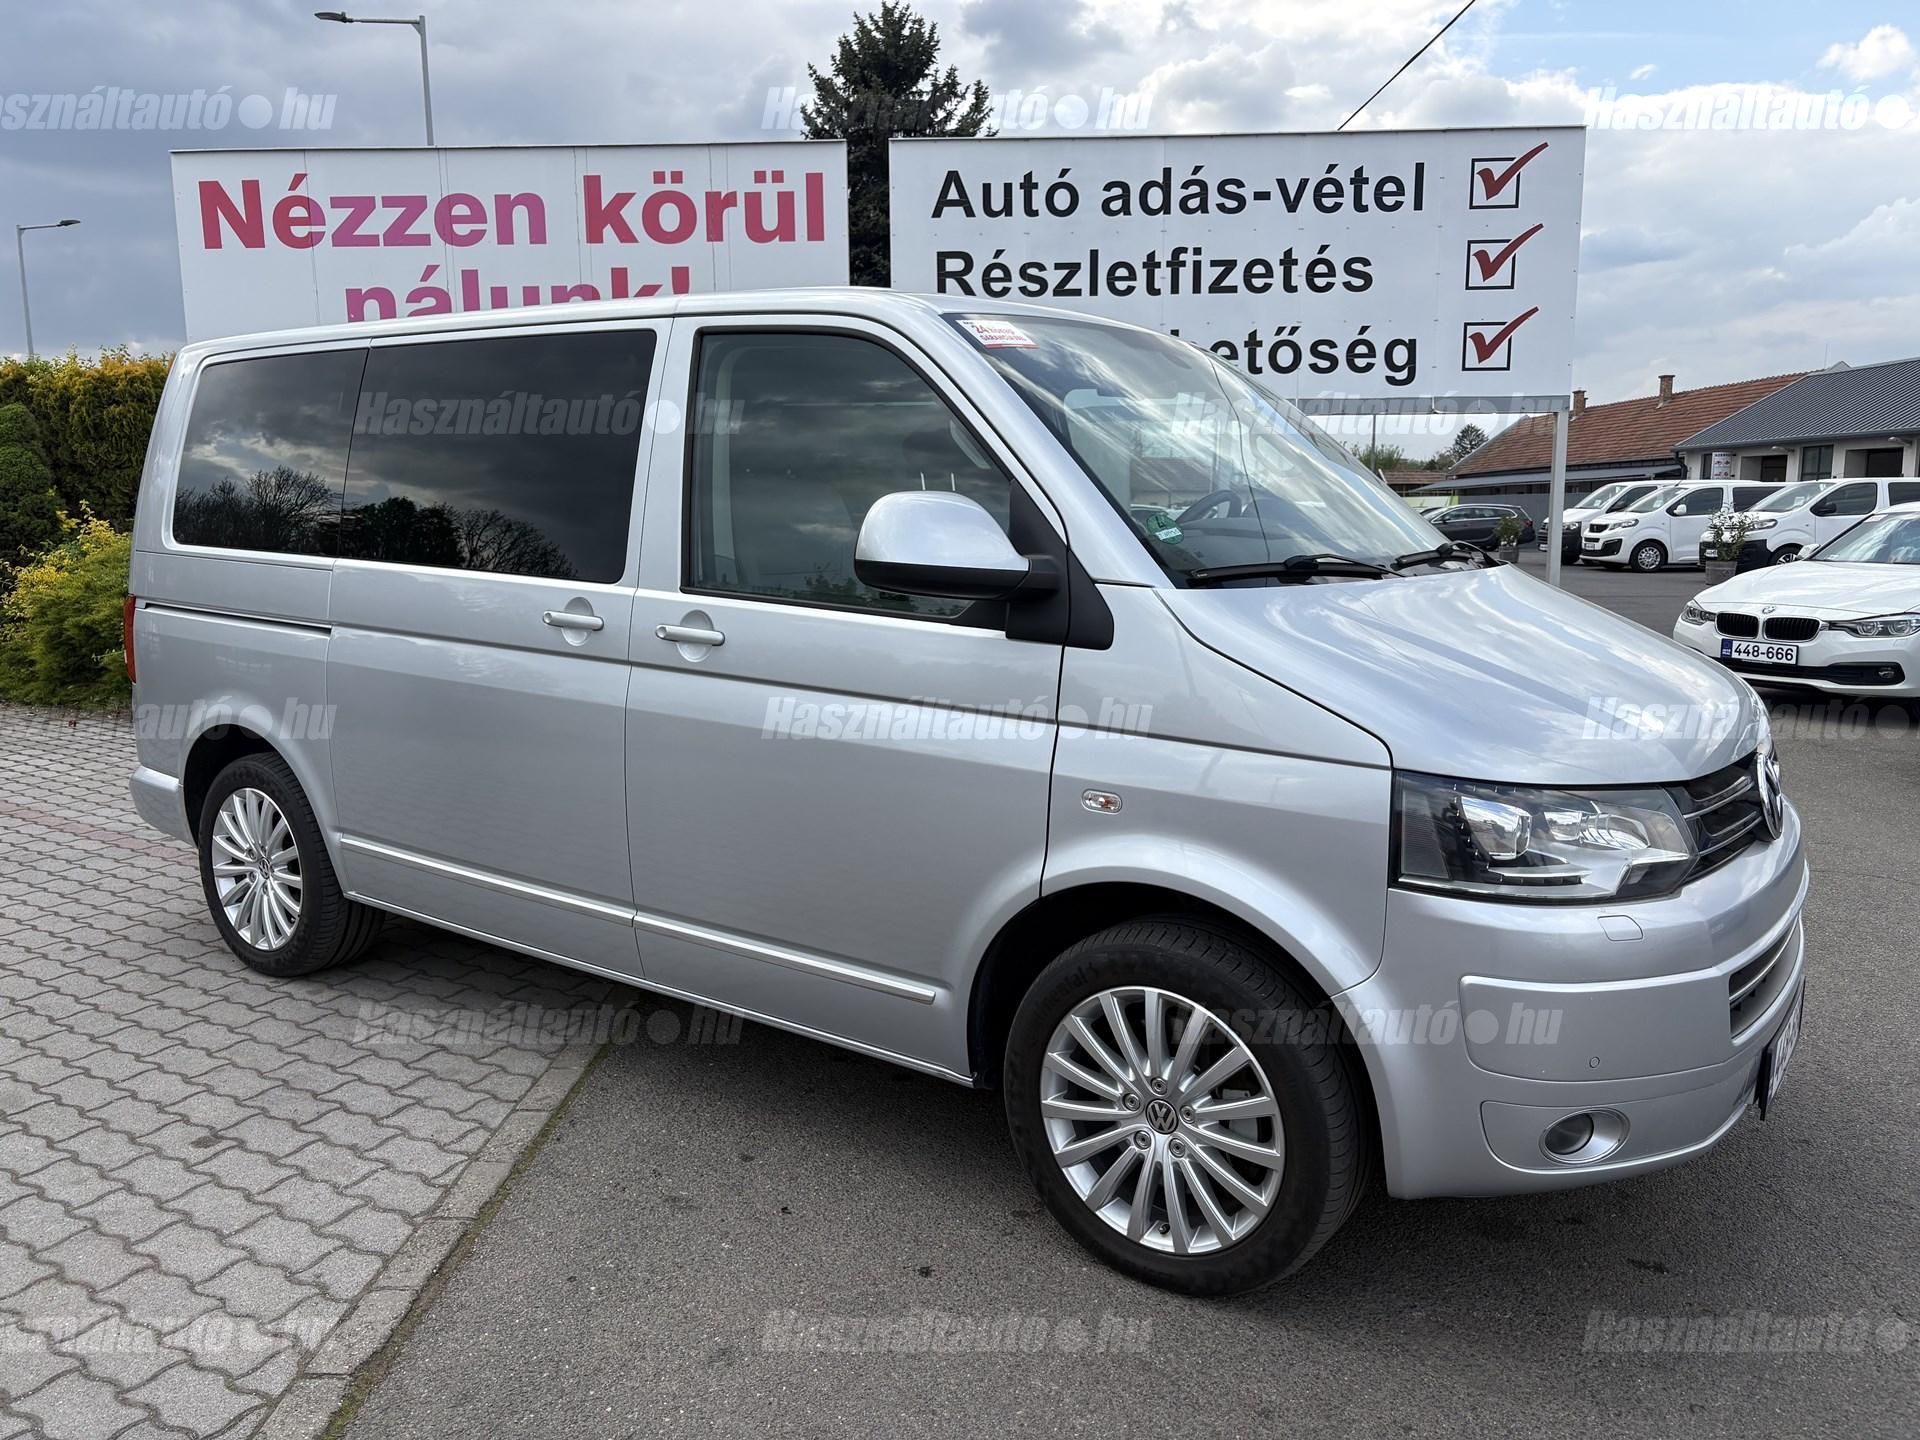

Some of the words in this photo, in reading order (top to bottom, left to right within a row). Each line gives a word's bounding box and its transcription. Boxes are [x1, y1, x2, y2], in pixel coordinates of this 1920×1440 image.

[200, 174, 546, 249] Nézzen
[584, 171, 825, 244] körül
[931, 169, 1080, 219] Autó
[1101, 162, 1425, 217] adás-vétel
[935, 244, 1374, 298] Részletfizetés
[1170, 325, 1417, 387] etőség
[1734, 643, 1794, 662] 448-666
